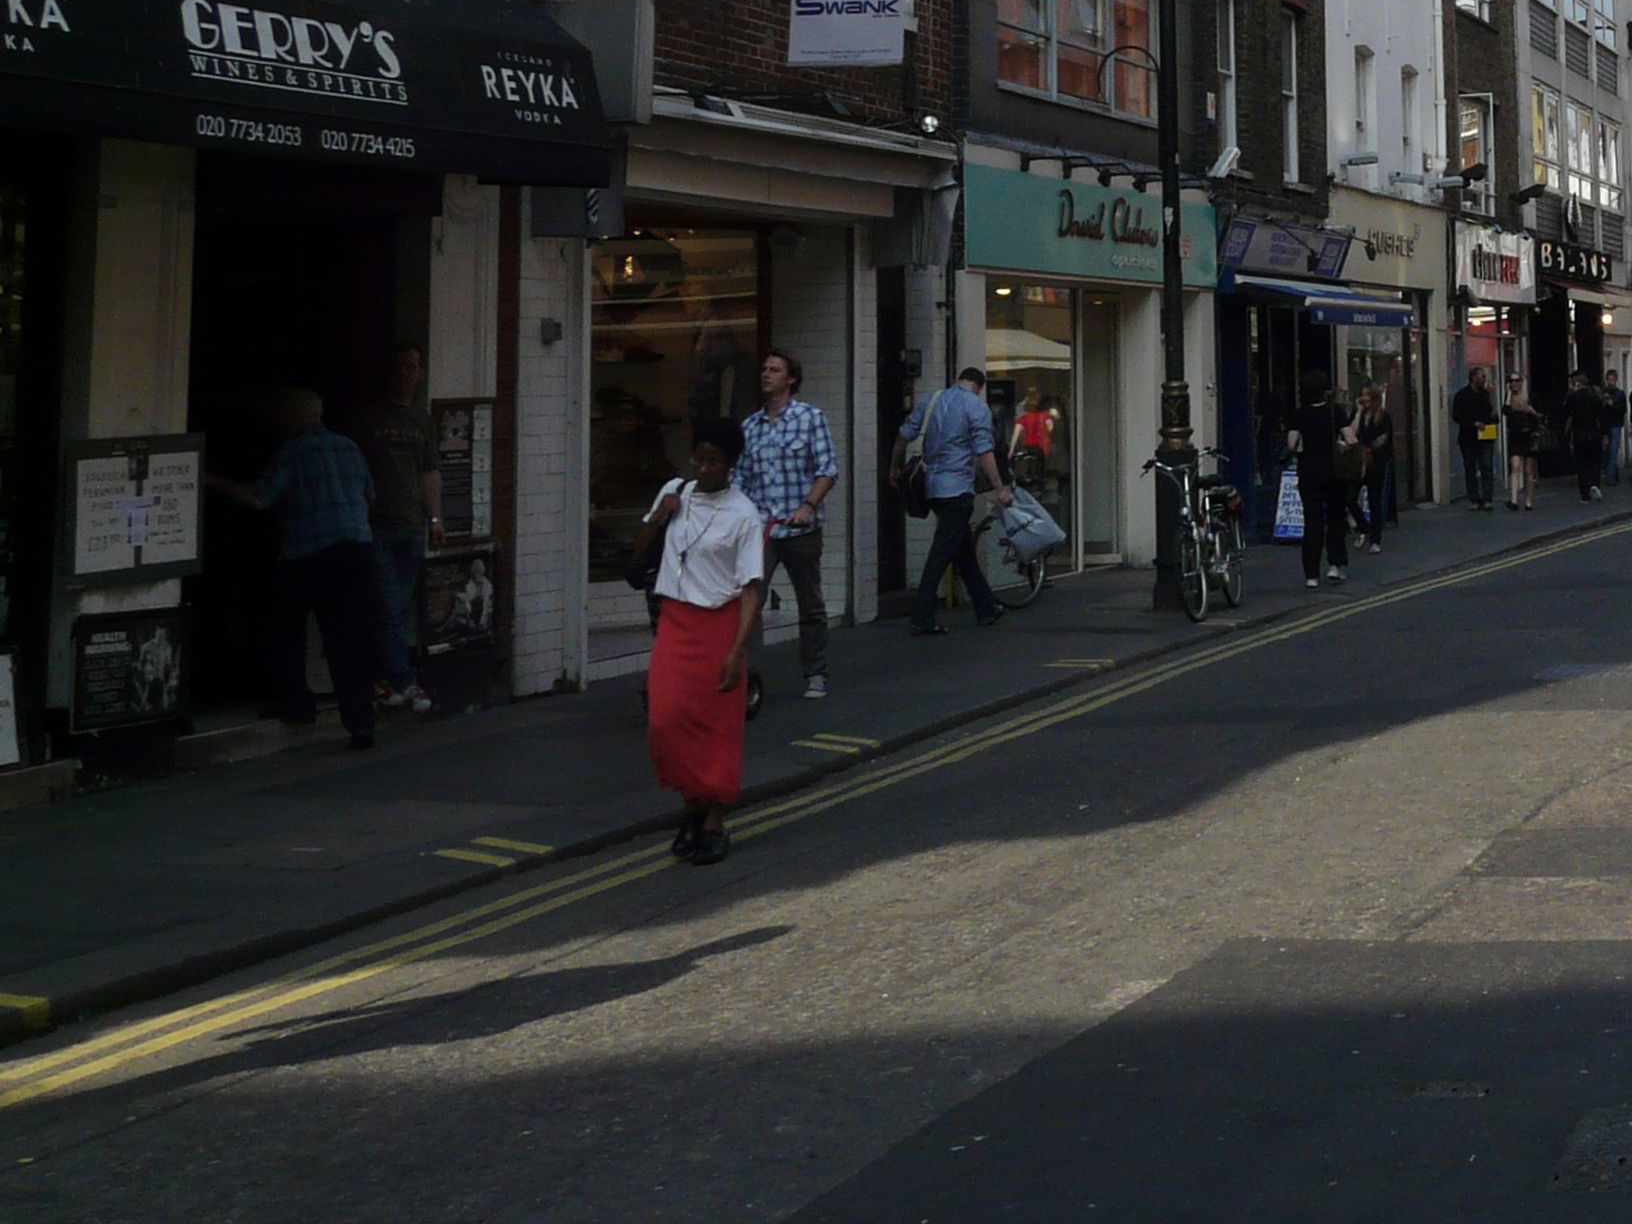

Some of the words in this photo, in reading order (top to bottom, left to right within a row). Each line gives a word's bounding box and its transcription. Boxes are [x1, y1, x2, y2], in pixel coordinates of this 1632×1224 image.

[189, 54, 275, 82] WINES
[285, 68, 298, 86] &
[307, 72, 408, 102] SPIRITS
[480, 63, 579, 110] REYKA
[196, 114, 225, 137] 020
[229, 118, 263, 142] 7734
[266, 123, 302, 147] 2053
[320, 129, 348, 152] 020
[351, 133, 384, 155] 7734
[385, 136, 416, 158] 4215
[514, 108, 563, 126] VODKA
[1058, 188, 1105, 241] David
